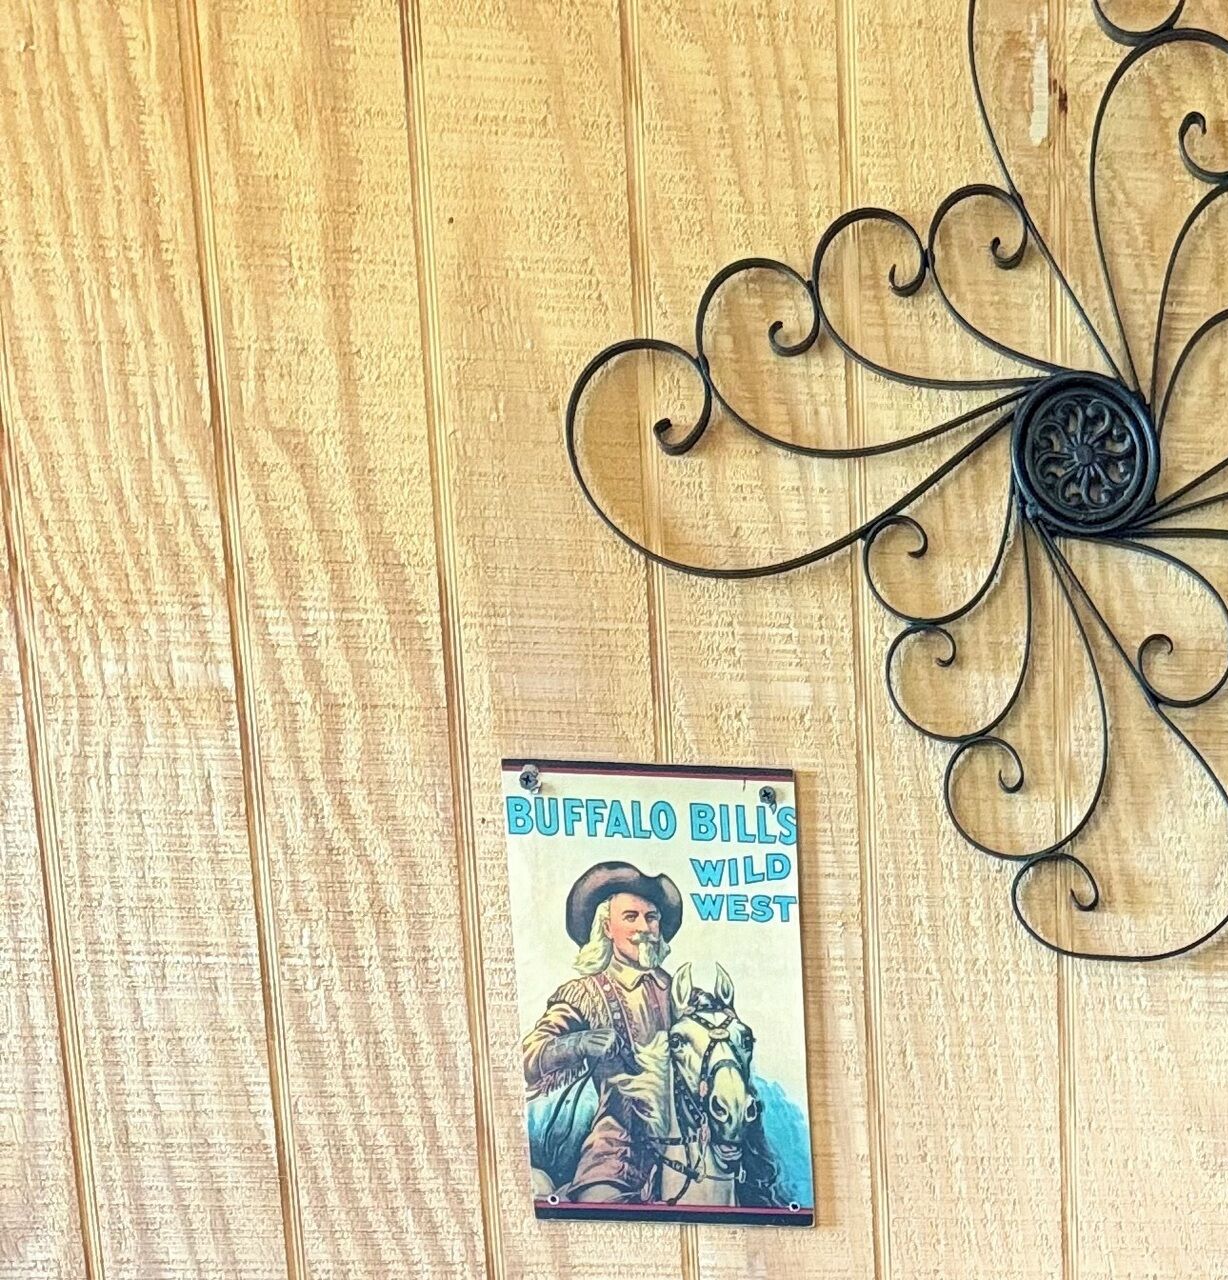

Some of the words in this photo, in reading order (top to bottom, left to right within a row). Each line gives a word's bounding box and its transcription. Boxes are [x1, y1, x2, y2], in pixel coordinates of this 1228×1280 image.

[505, 795, 677, 840] BUFFALO
[689, 802, 798, 845] BILL'S
[689, 853, 791, 887] WILD
[690, 893, 797, 922] WEST
